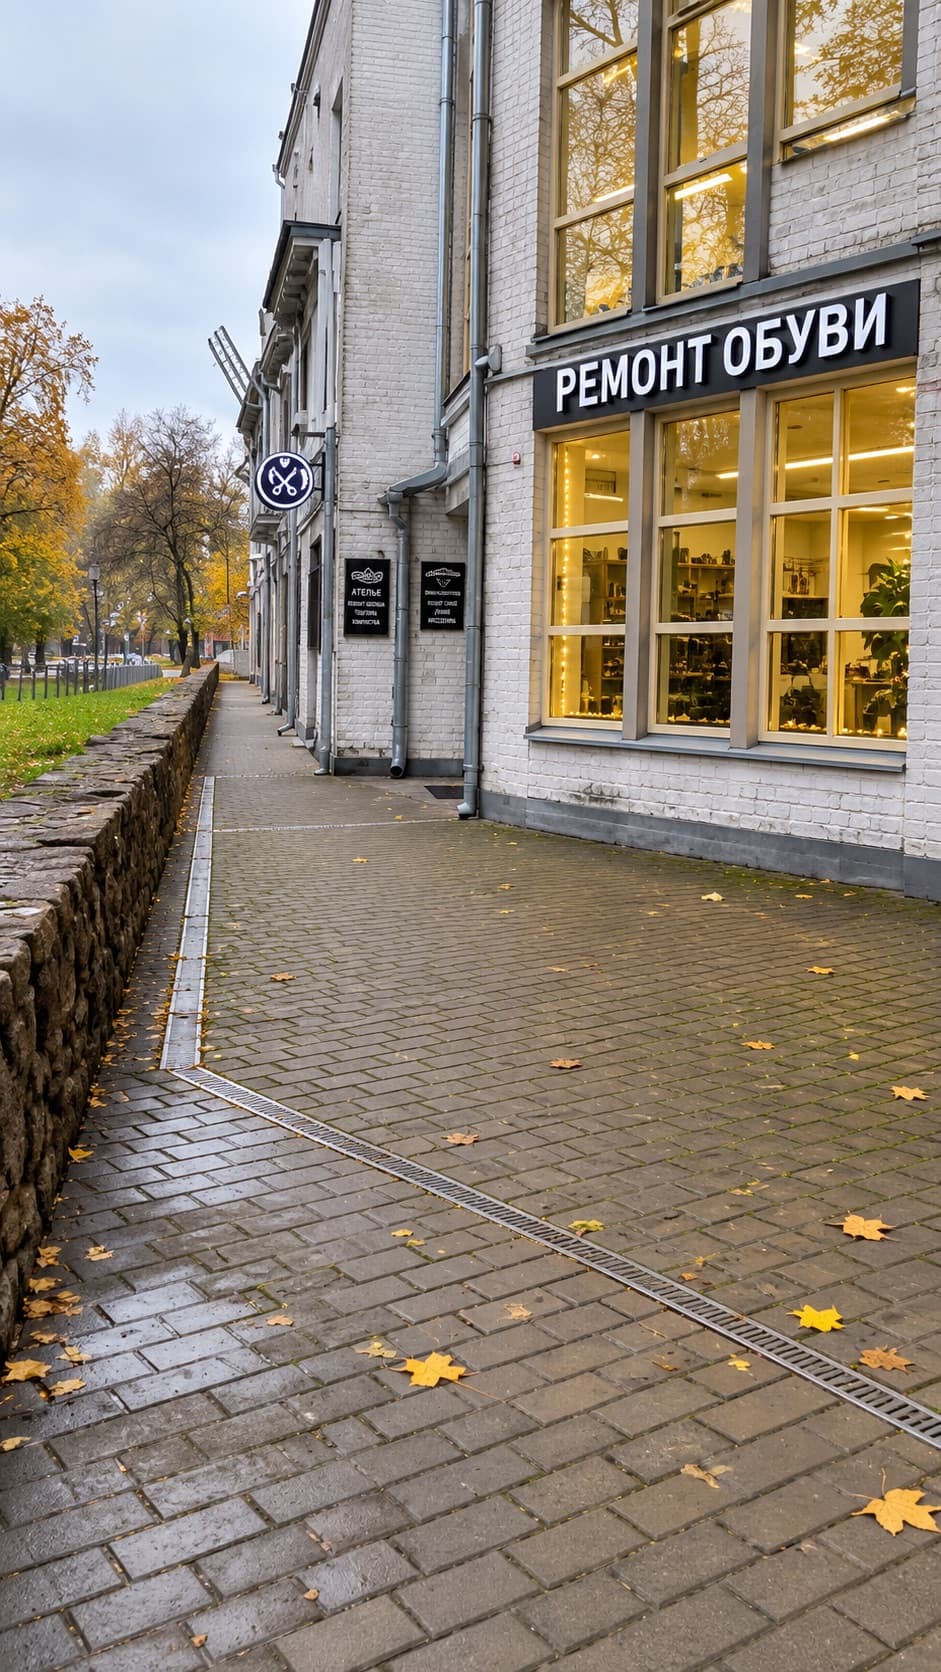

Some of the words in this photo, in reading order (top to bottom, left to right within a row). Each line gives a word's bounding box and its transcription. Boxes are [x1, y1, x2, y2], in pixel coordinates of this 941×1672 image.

[556, 334, 712, 412] РЕМОНТ
[723, 292, 887, 376] ОБУВИ
[351, 588, 382, 597] АТЕЛЬЕ
